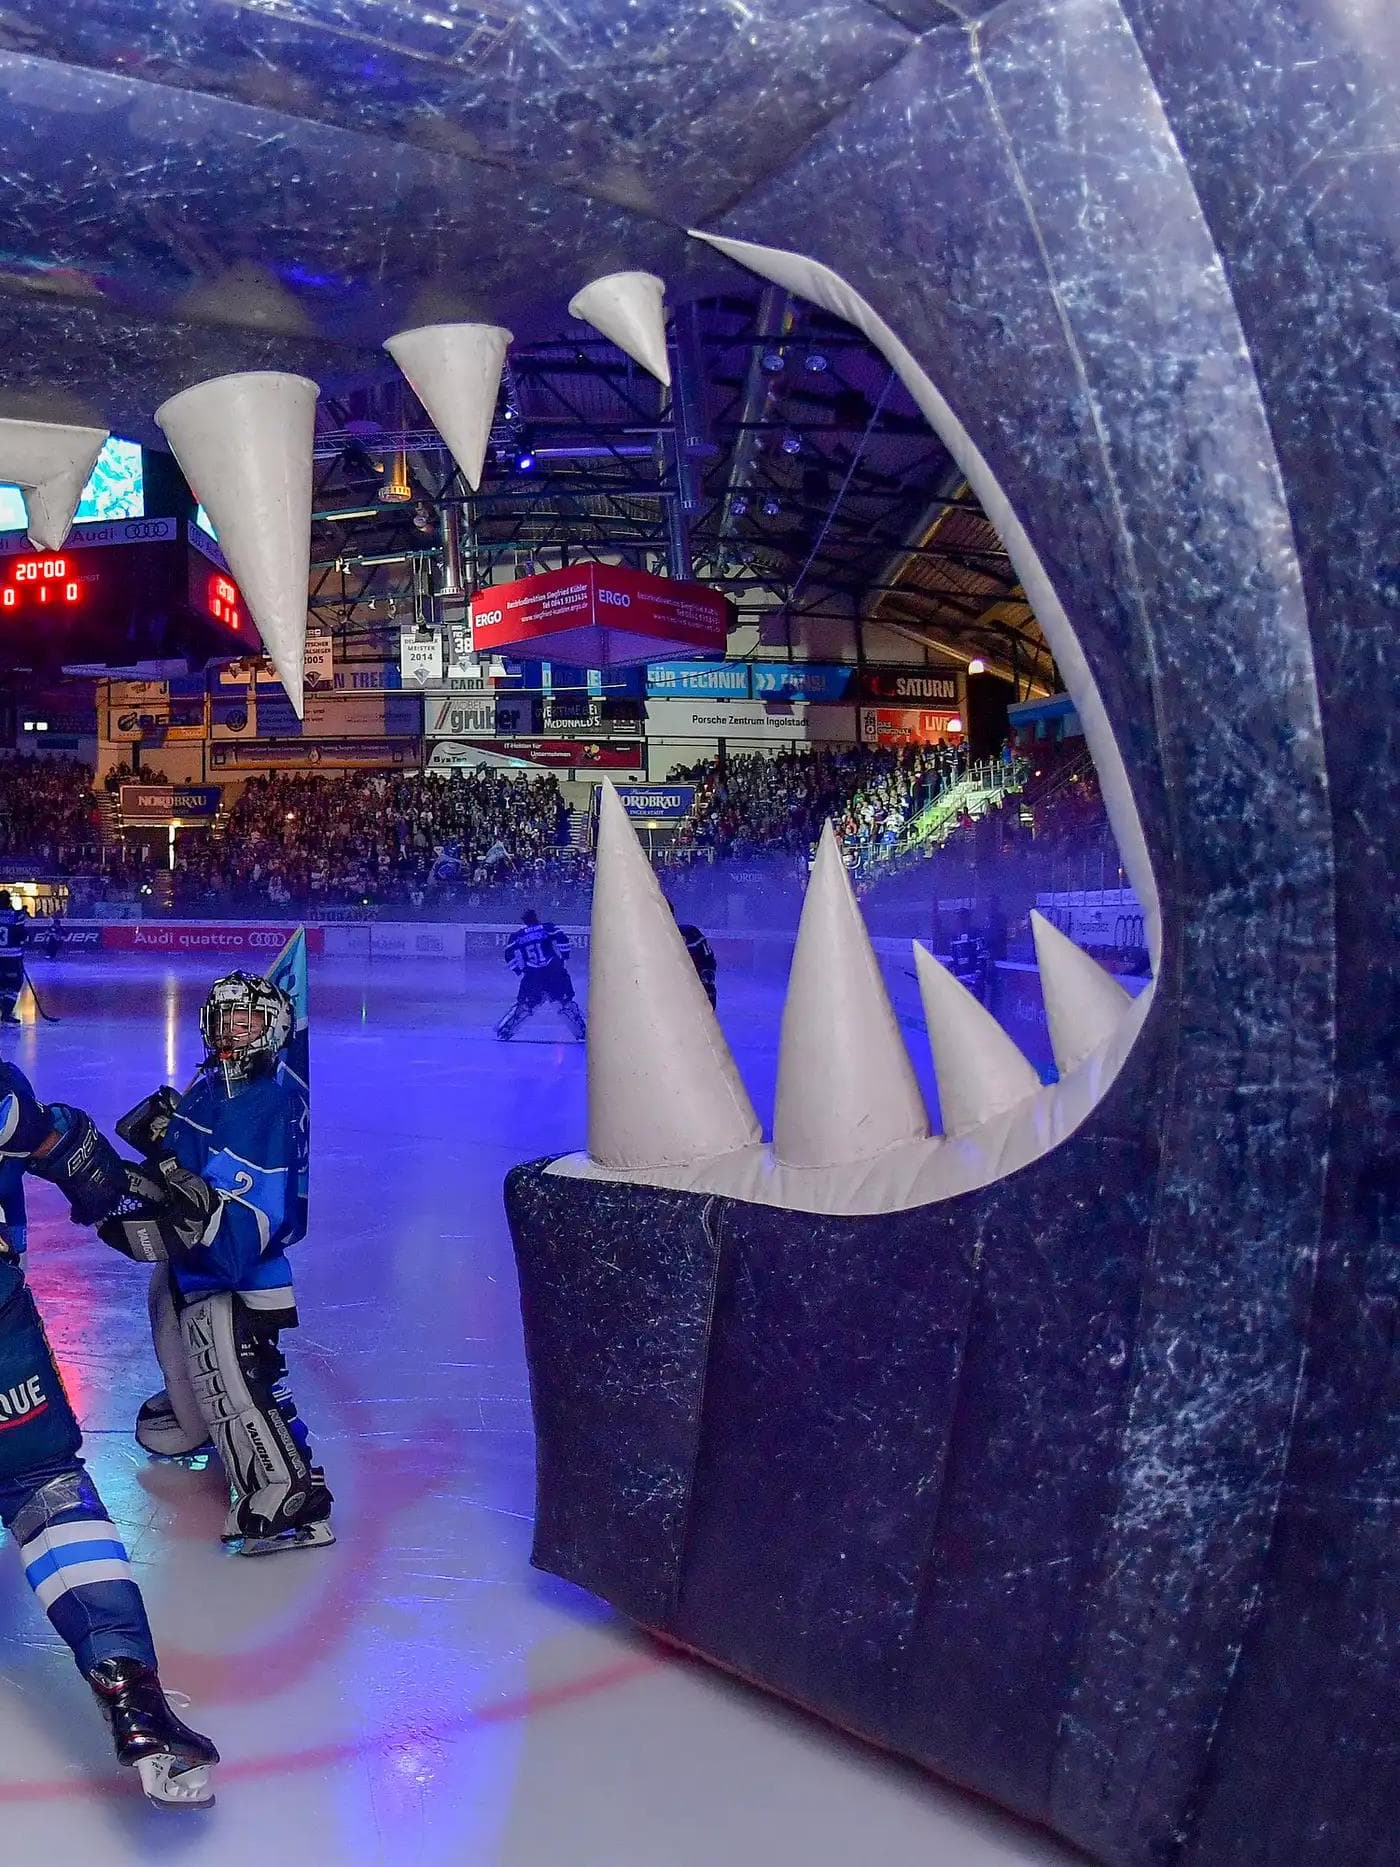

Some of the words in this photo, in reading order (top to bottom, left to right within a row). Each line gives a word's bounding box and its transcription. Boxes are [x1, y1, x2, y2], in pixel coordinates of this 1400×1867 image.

[74, 528, 113, 542] Audi
[4, 588, 15, 606] 0
[66, 583, 77, 600] 0
[599, 589, 631, 607] ERGO
[475, 610, 503, 628] ERGO
[454, 638, 473, 653] 38
[410, 653, 433, 661] 2014
[681, 669, 748, 689] TECHNIK
[896, 678, 955, 697] SATURN
[450, 706, 521, 734] gruber
[692, 714, 727, 725] Porsche
[728, 715, 765, 726] Zentrum
[766, 717, 809, 728] Ingolstadt
[622, 795, 681, 809] ORDBRÄU
[134, 930, 174, 945] Audi
[179, 933, 243, 947] quattro
[245, 1420, 275, 1472] VAUGHN
